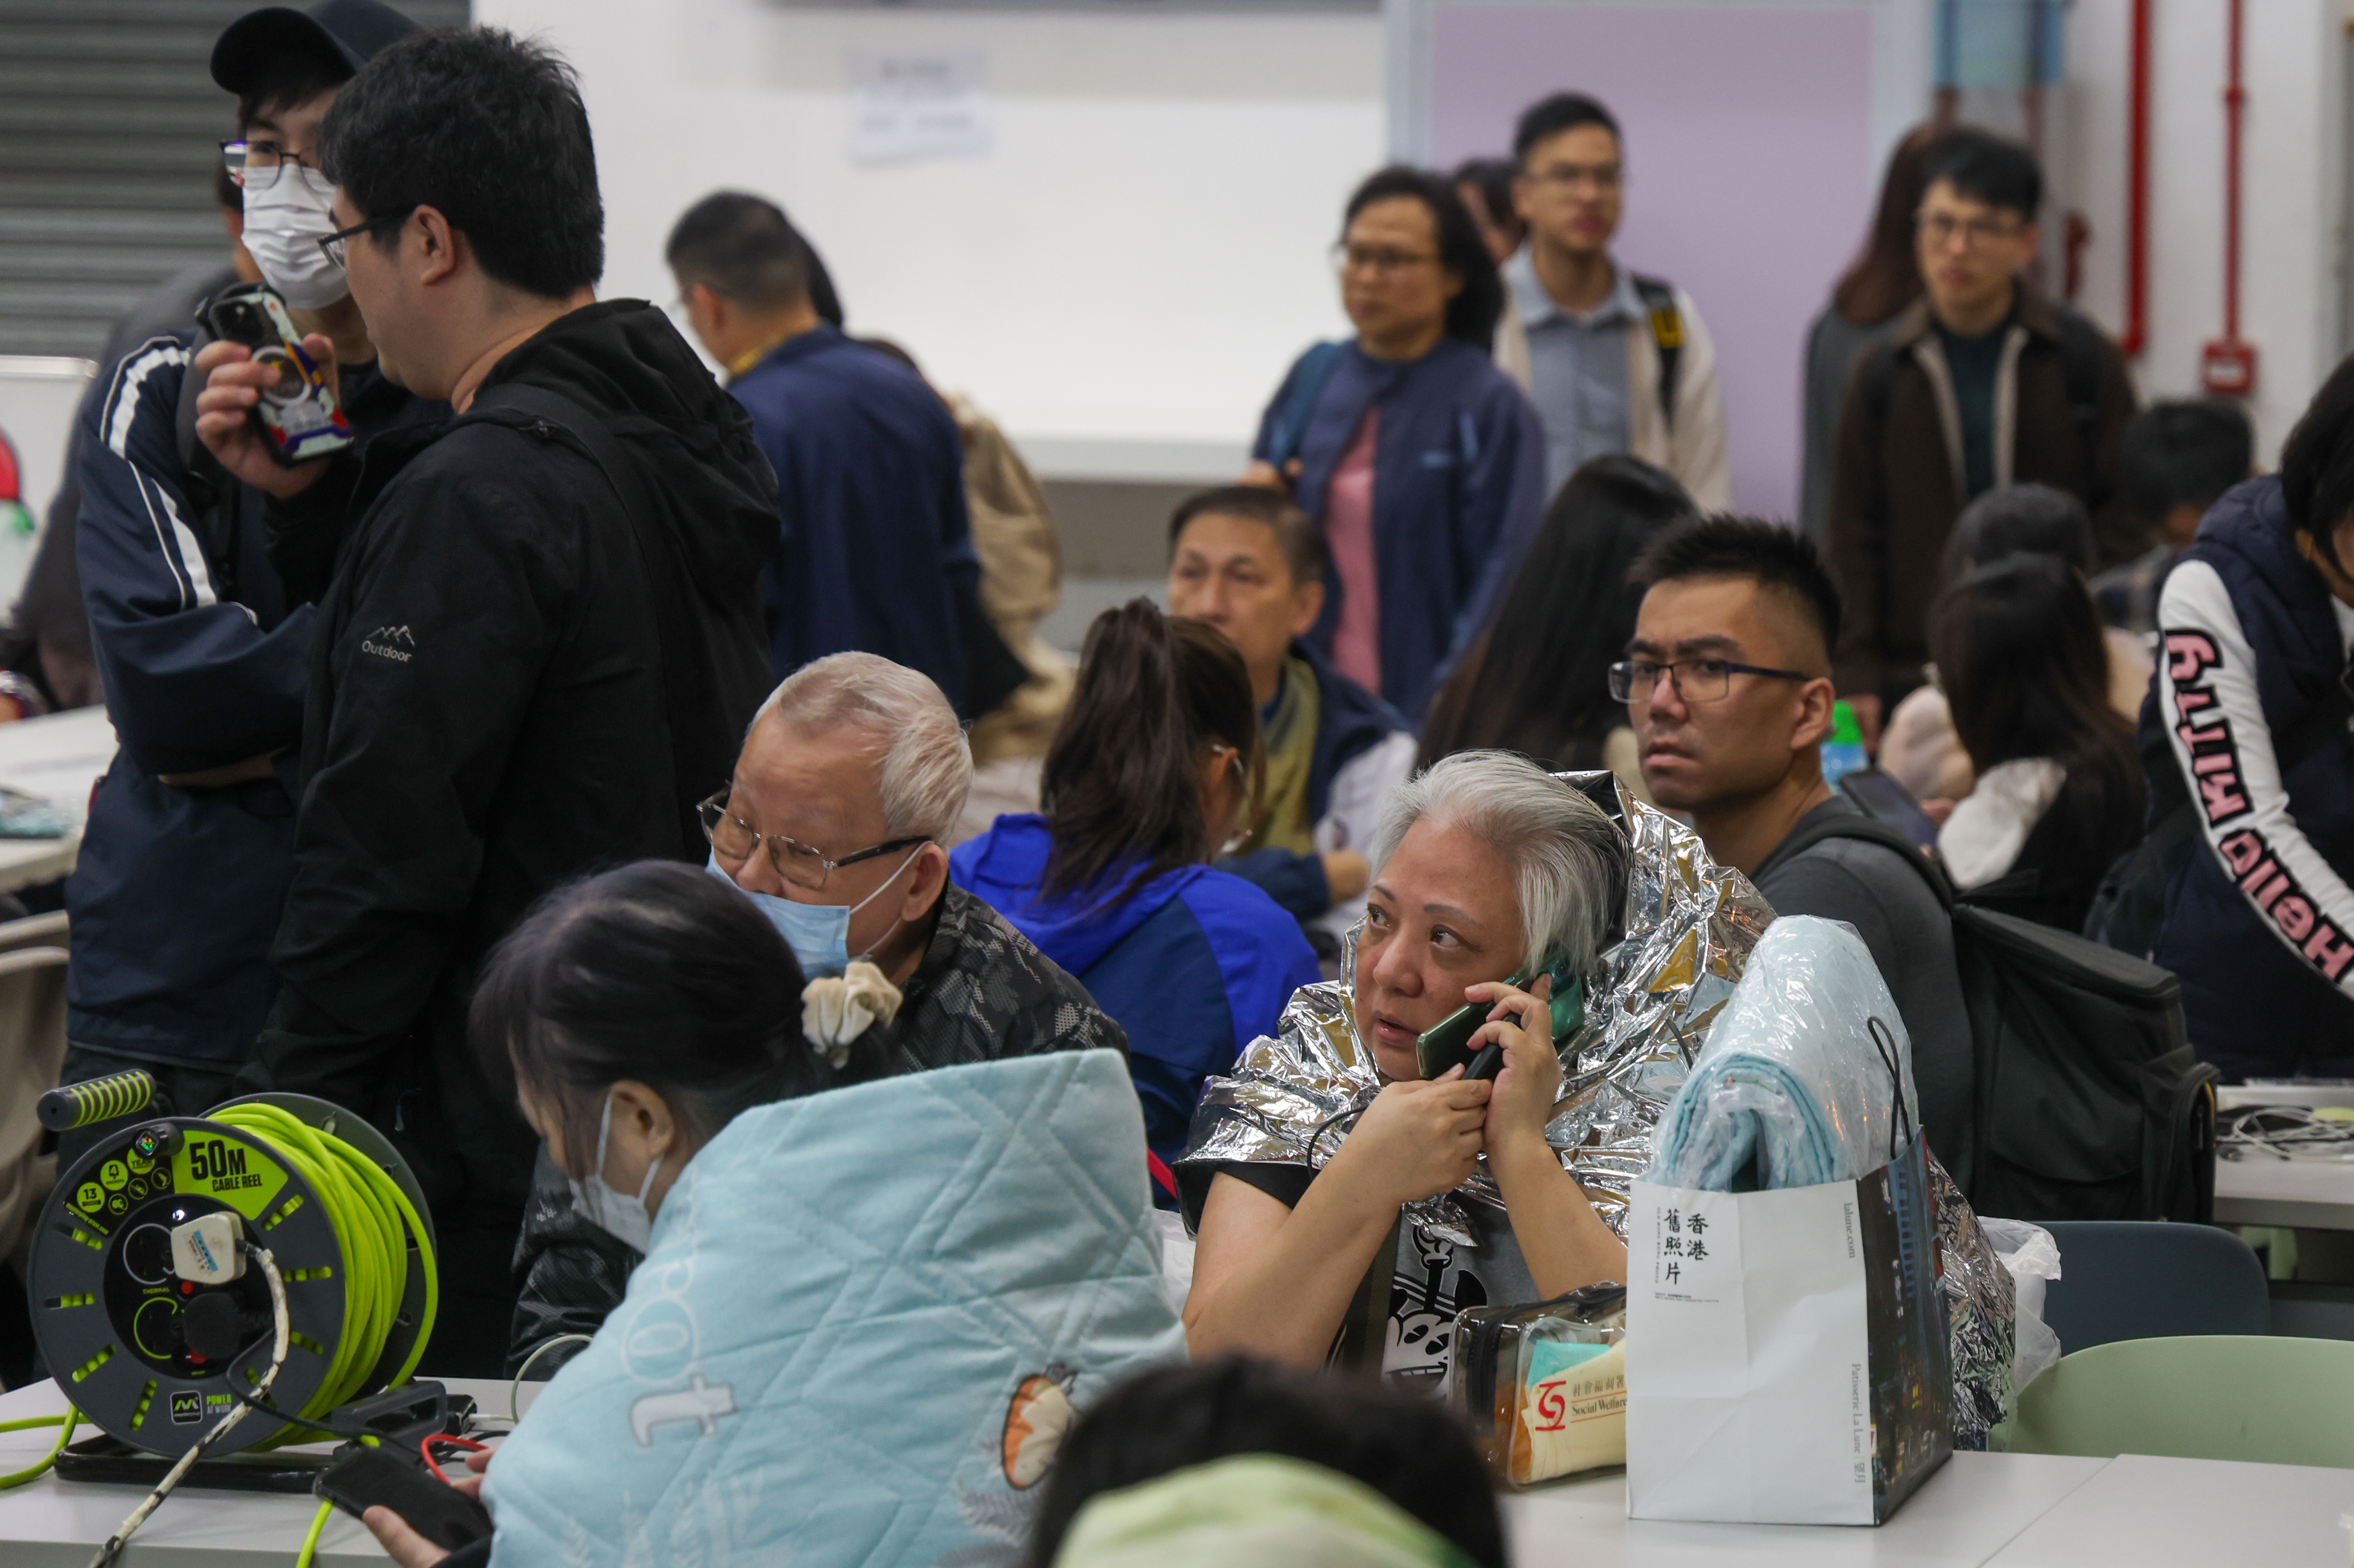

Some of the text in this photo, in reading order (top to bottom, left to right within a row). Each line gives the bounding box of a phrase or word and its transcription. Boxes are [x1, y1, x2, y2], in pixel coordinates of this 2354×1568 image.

[362, 640, 412, 663] Outdoor
[2219, 829, 2354, 983] Hello
[190, 1140, 246, 1180] 50M
[83, 1188, 97, 1200] 13
[212, 1174, 263, 1192] CABLE REEL
[1664, 1208, 1683, 1286] 舊照片
[1687, 1213, 1709, 1261] 香港
[1572, 1402, 1597, 1417] Social
[1852, 1364, 1863, 1454] Patisserie La Lune
